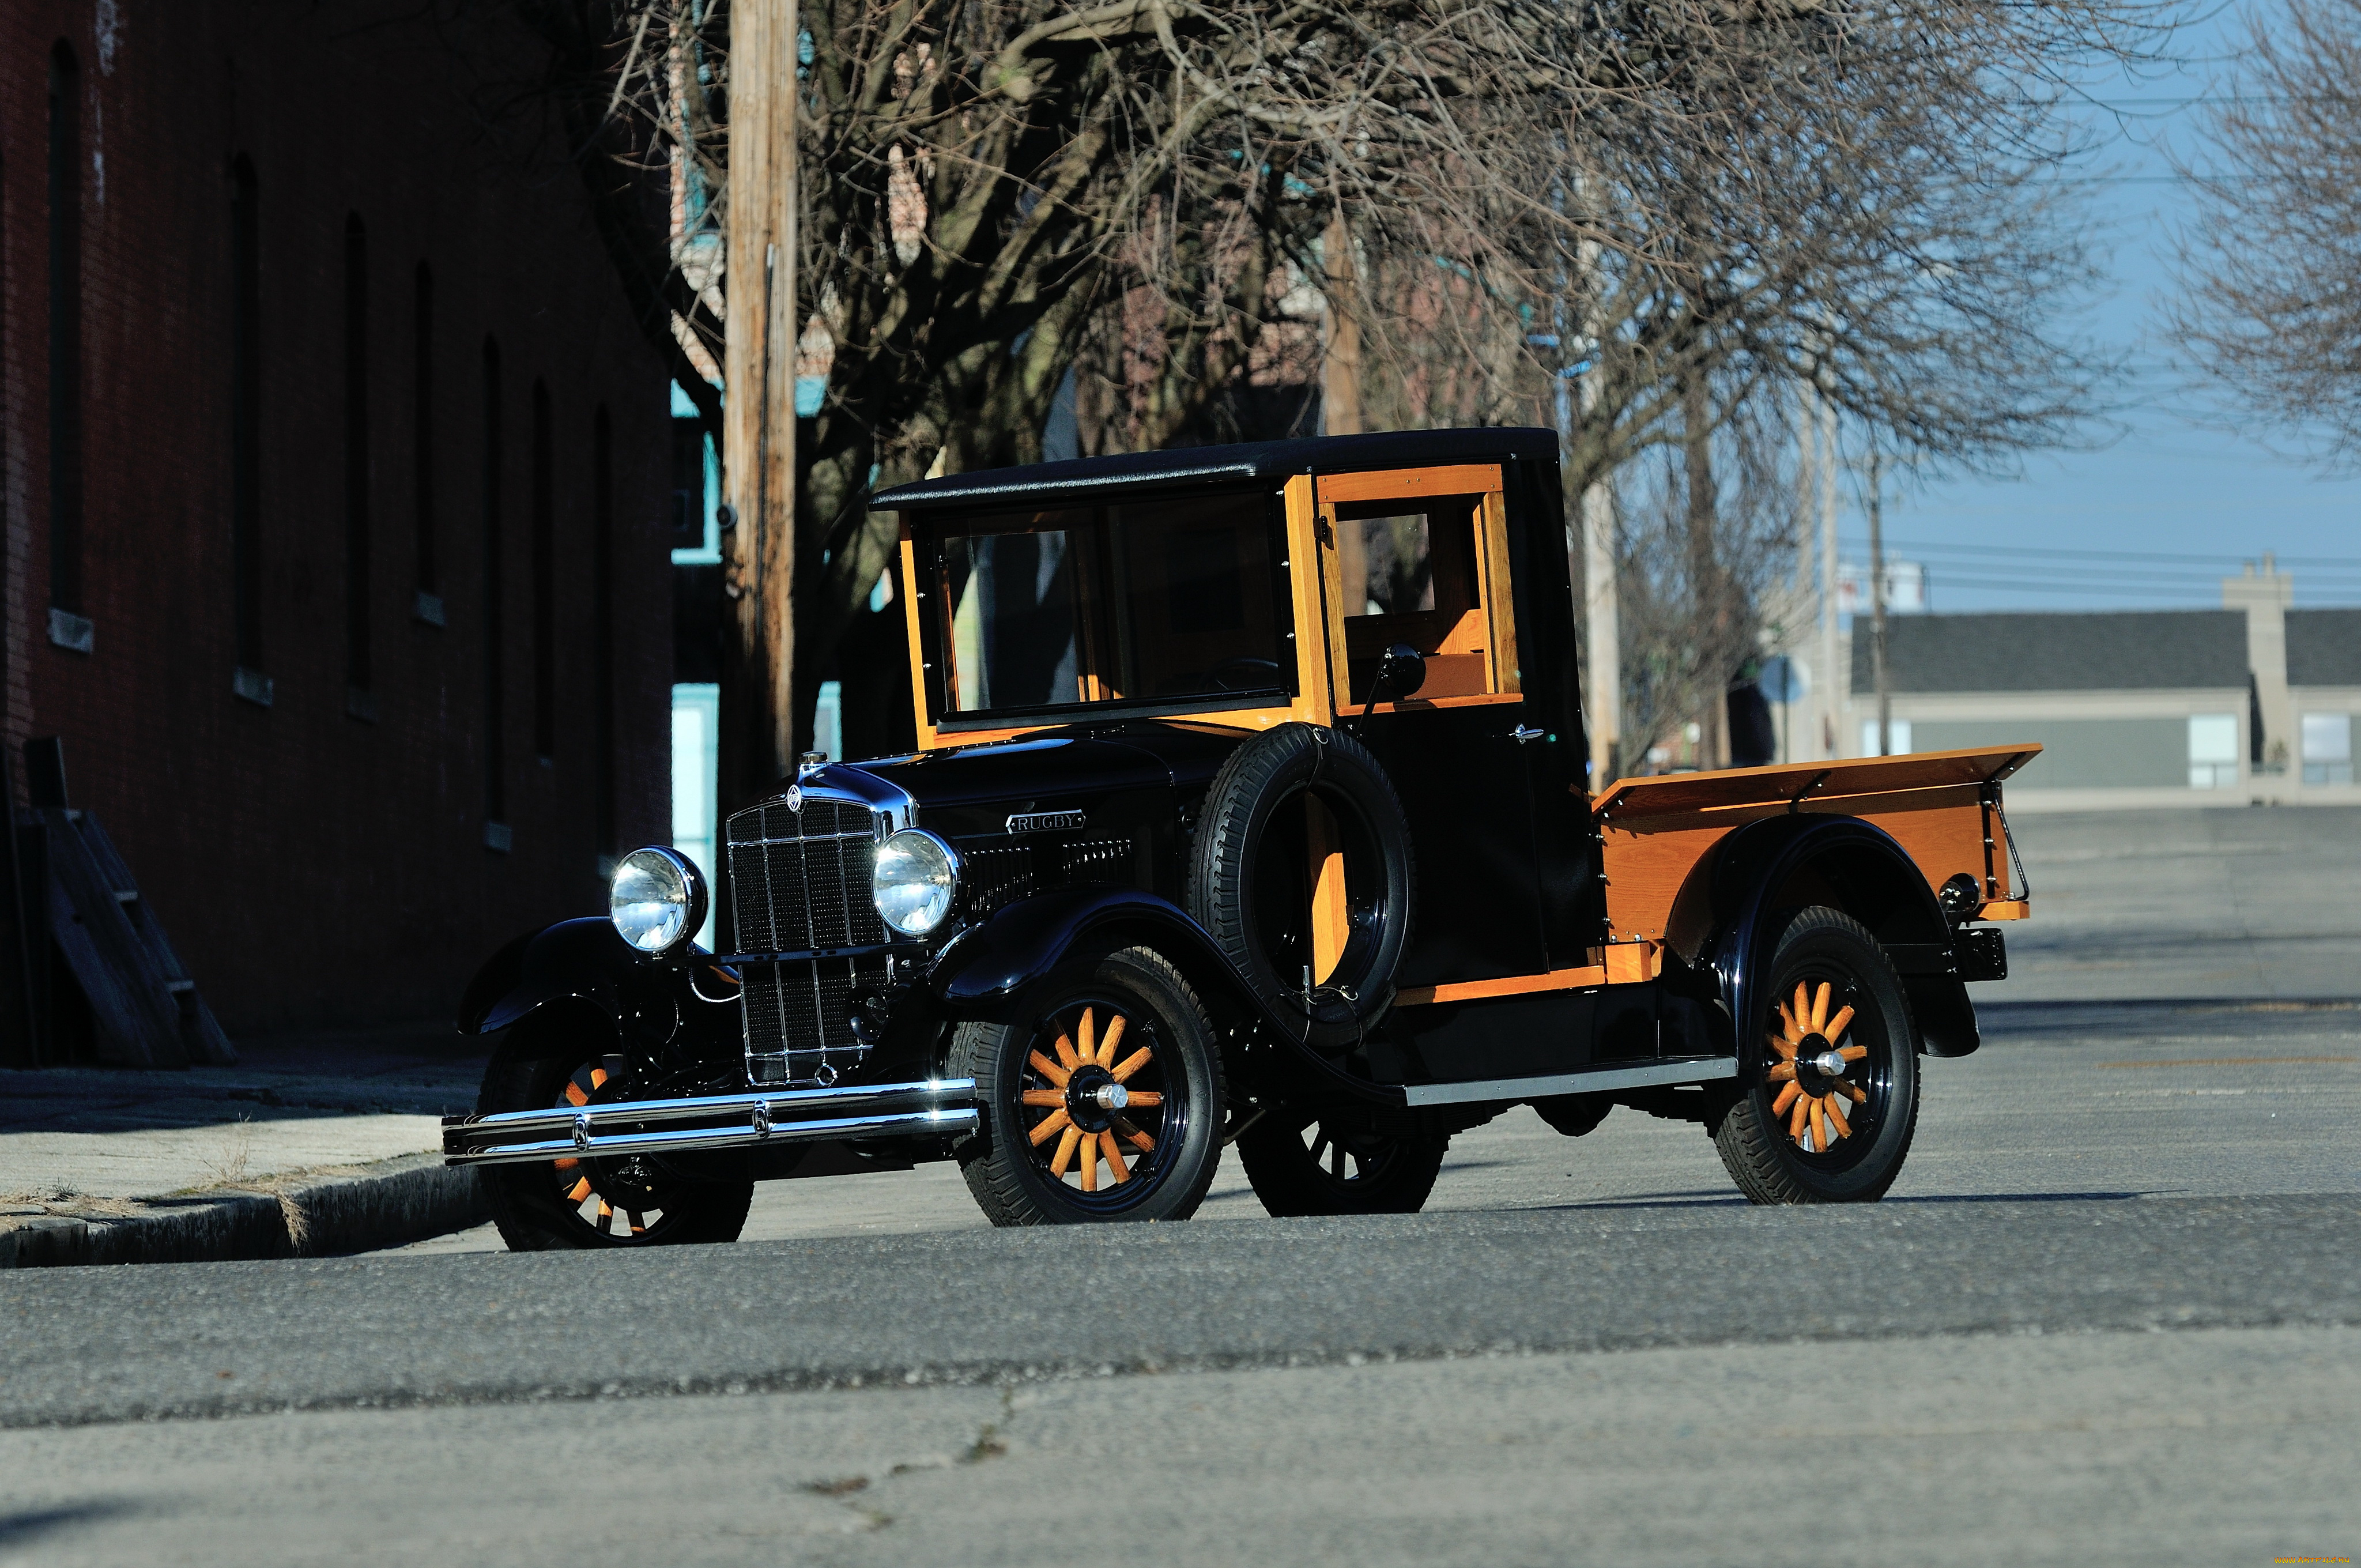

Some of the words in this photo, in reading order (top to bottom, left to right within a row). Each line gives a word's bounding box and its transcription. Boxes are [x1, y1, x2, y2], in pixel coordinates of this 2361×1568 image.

[1018, 814, 1076, 831] RUGBY
[755, 1107, 765, 1129] R
[575, 1120, 585, 1143] R
